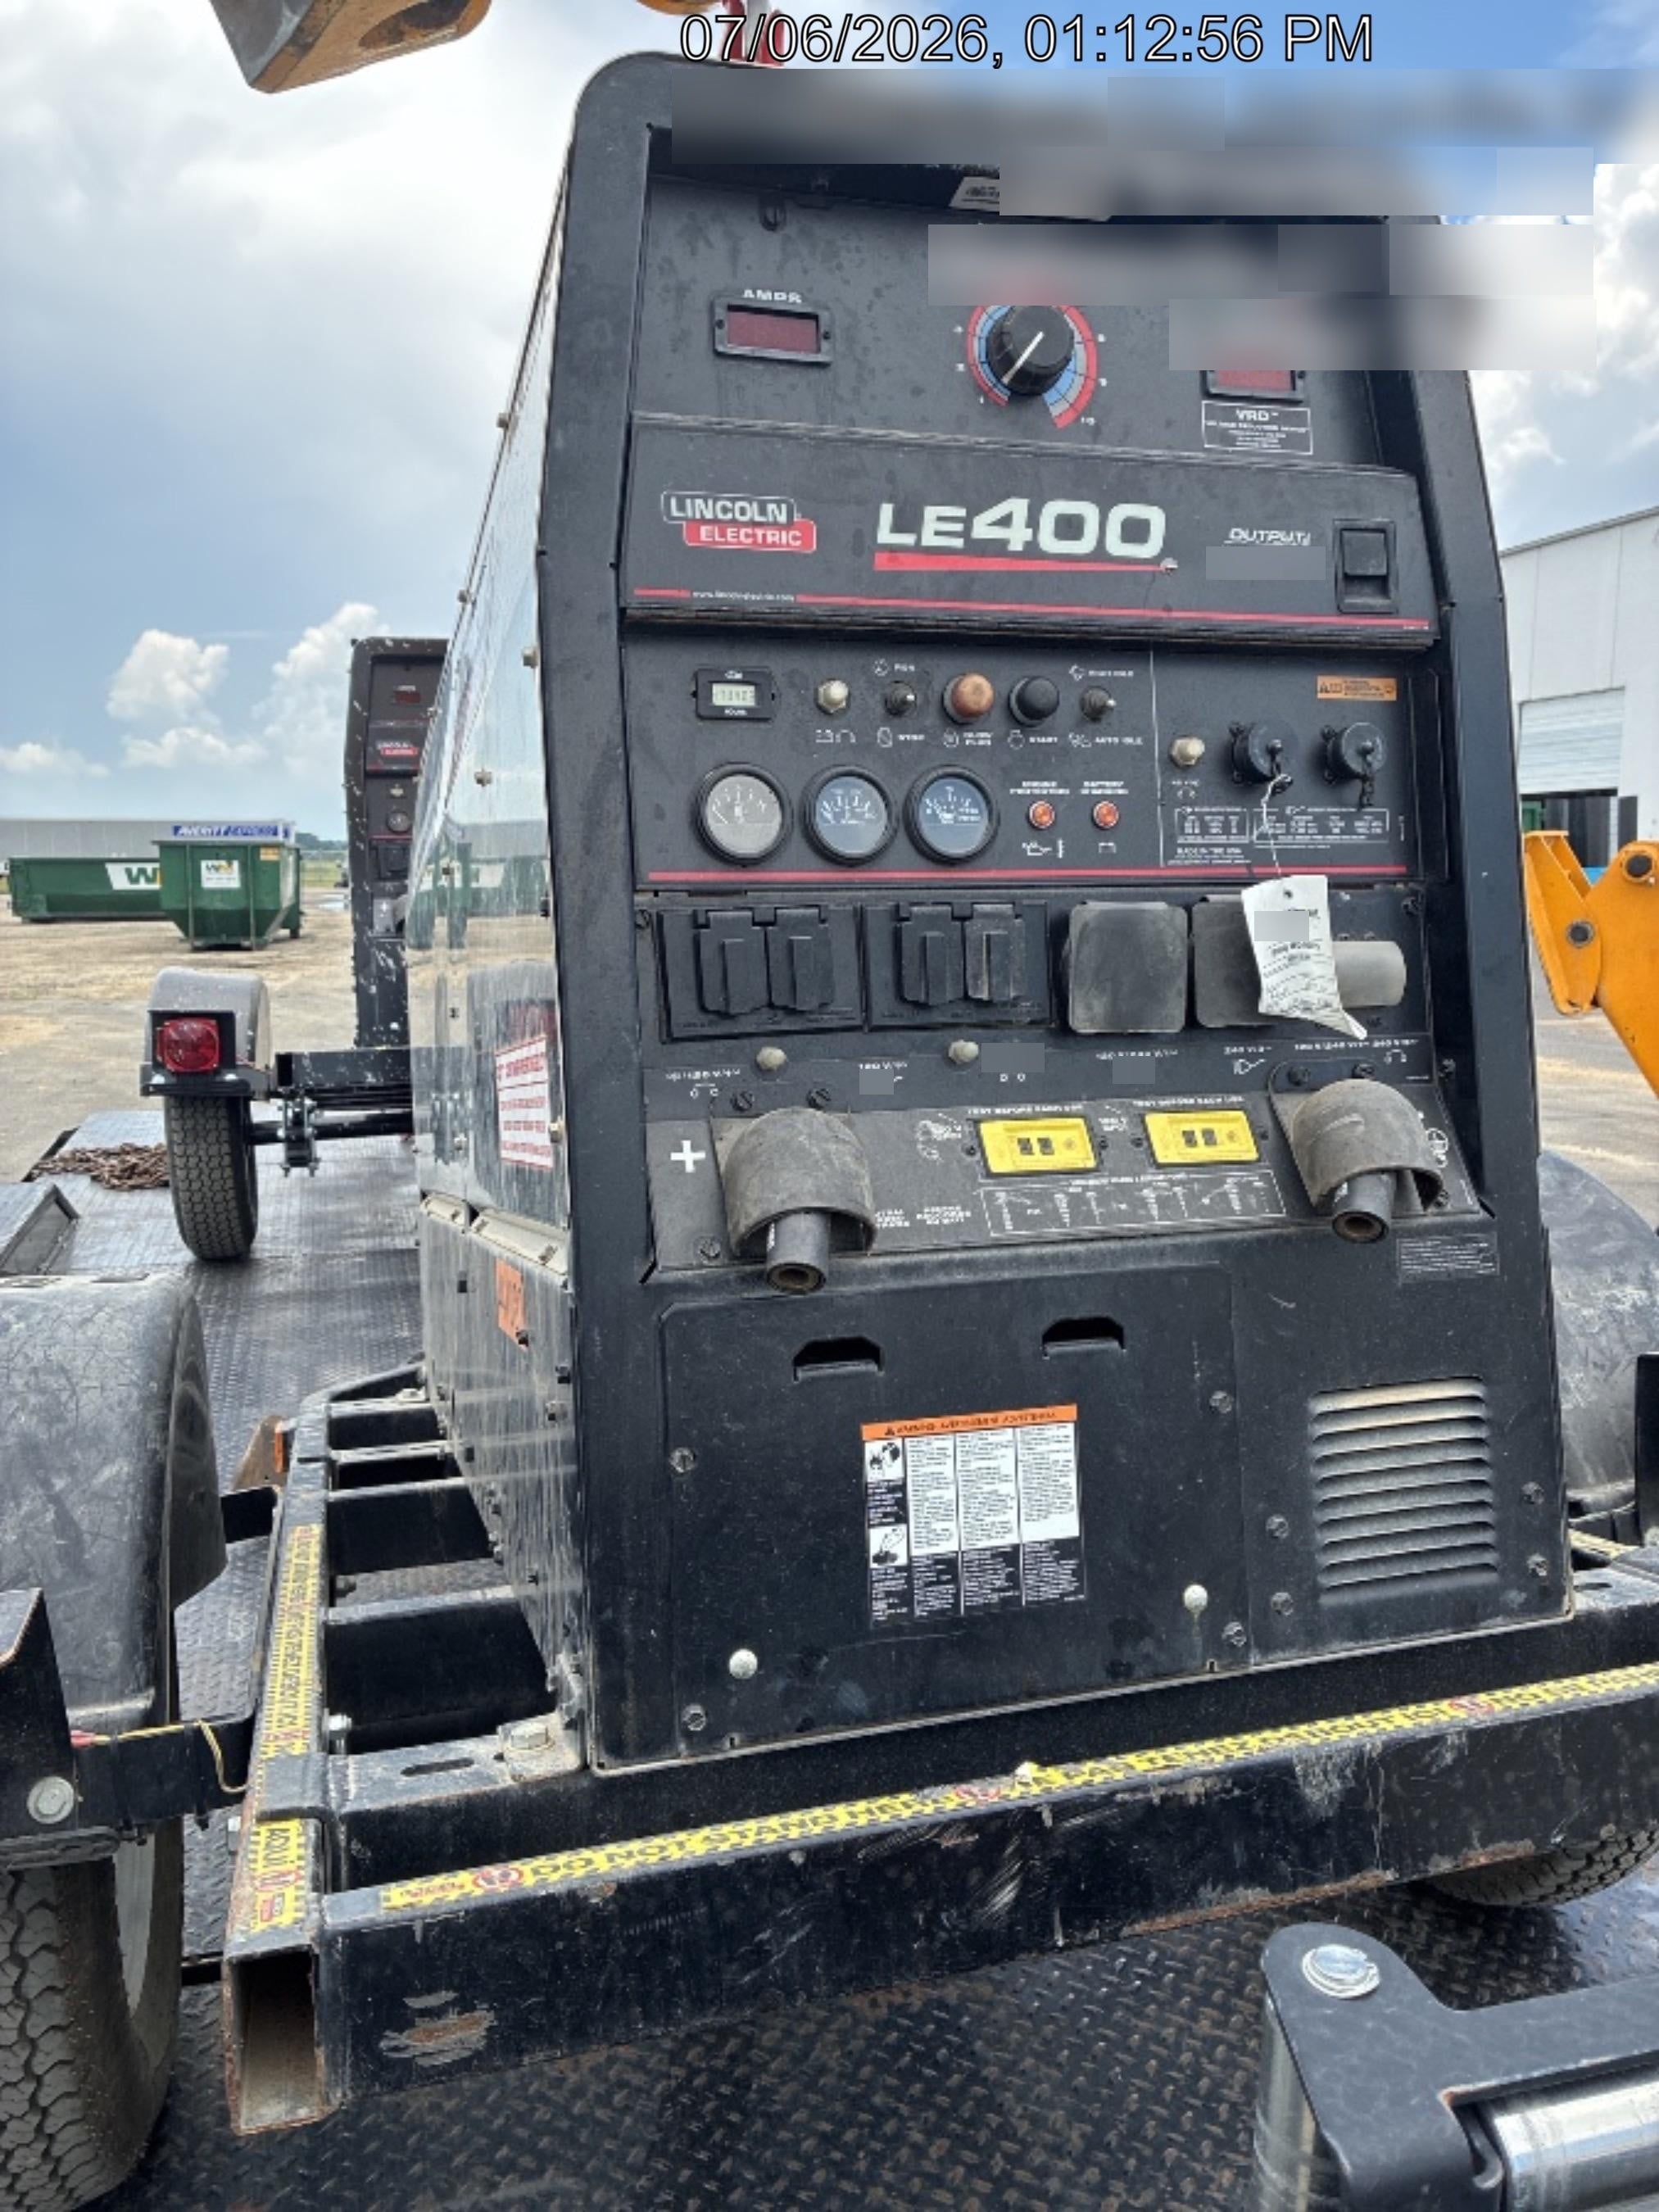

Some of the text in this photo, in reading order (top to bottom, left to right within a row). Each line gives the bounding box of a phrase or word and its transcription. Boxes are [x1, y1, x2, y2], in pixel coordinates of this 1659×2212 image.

[670, 496, 787, 524] LINCOLN
[700, 525, 803, 546] ELECTRIC
[877, 496, 1166, 559] LE400
